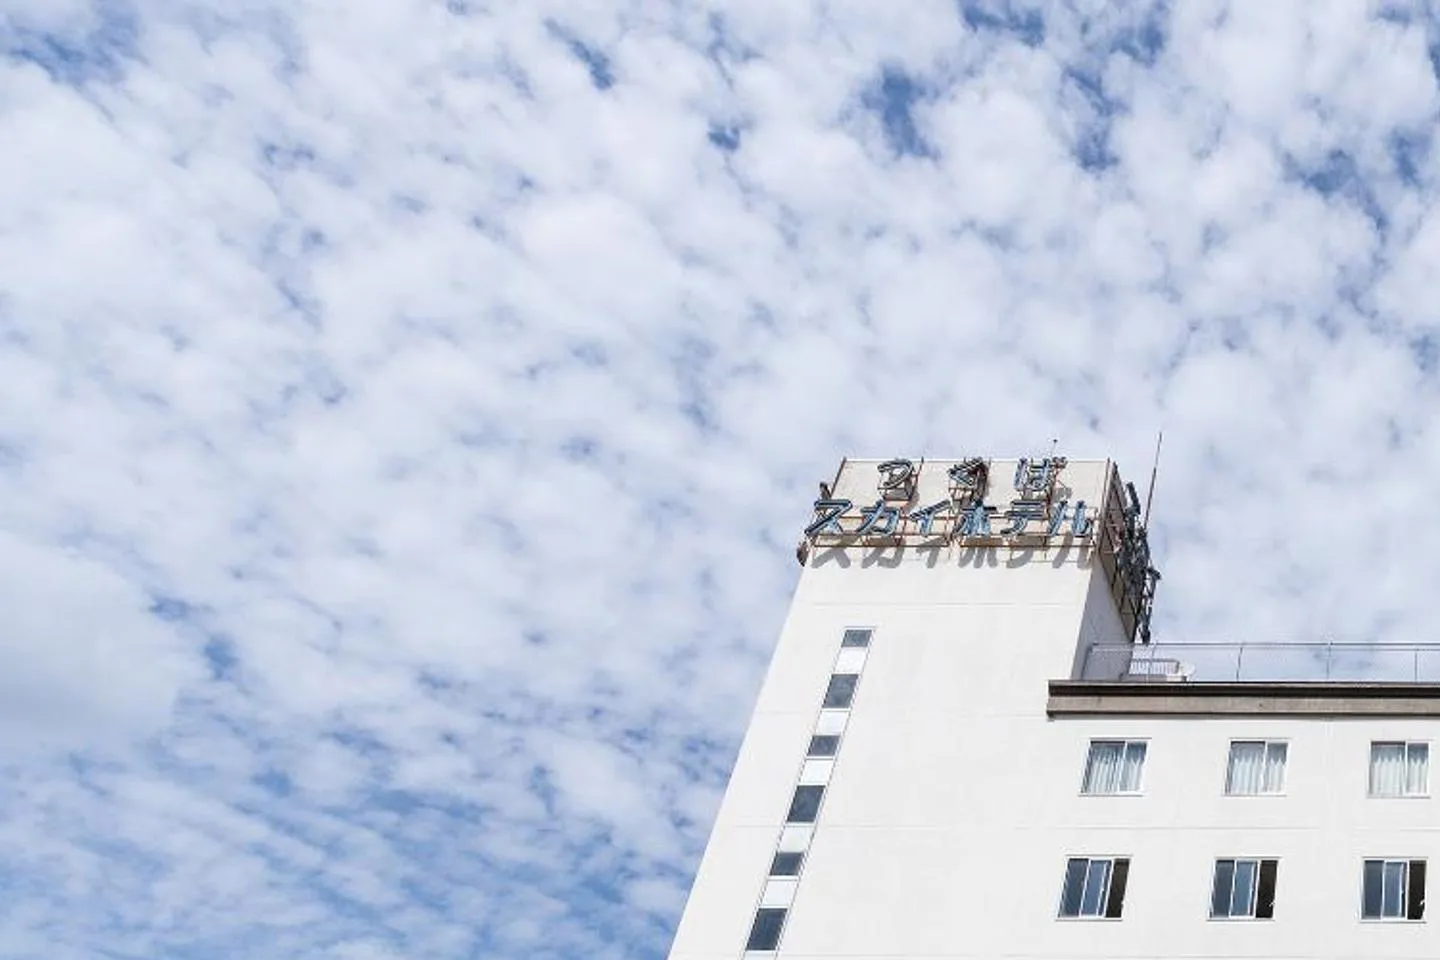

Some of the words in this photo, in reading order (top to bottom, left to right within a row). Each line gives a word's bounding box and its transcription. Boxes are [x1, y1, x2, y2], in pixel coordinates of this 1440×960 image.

[877, 456, 1068, 491] つくば
[804, 499, 1094, 538] スカイホテル
